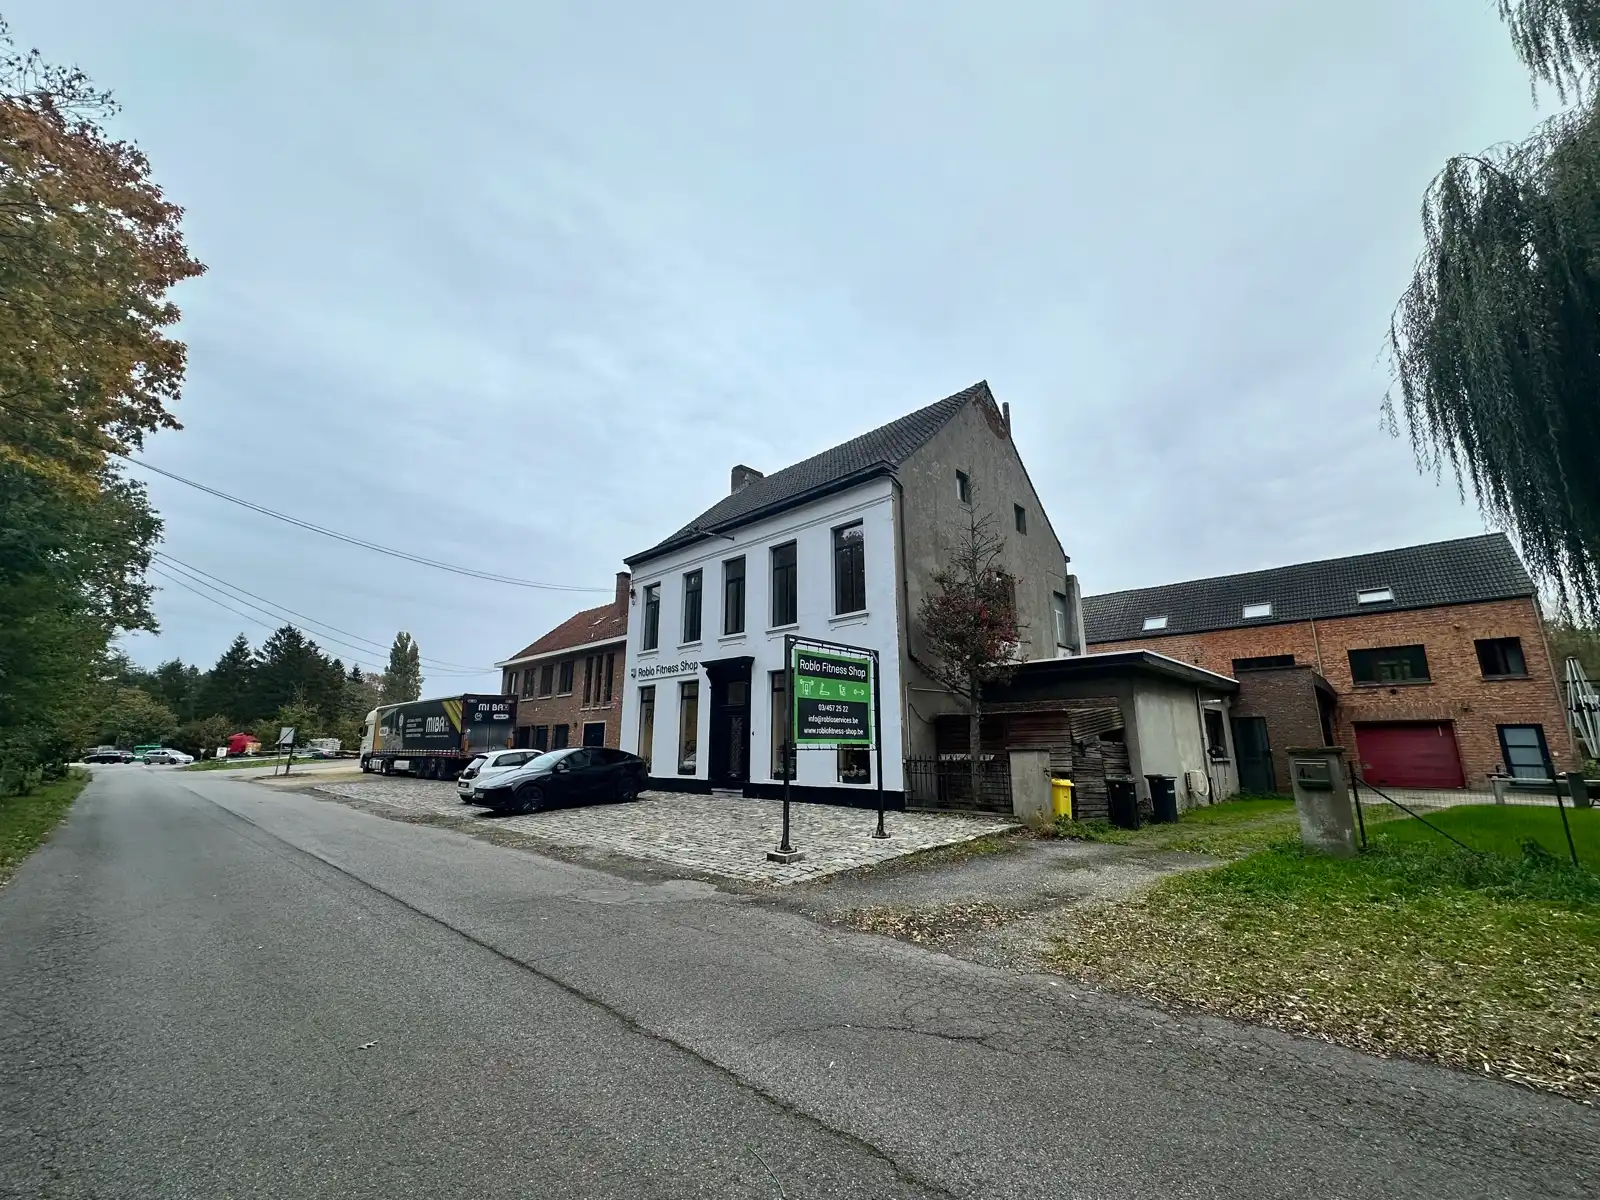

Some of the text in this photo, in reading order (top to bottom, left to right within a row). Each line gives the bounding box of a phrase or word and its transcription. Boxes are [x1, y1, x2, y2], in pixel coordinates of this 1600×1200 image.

[638, 660, 698, 677] Roblo Fitness Shop
[799, 659, 866, 679] Roblo Fitness Shop
[425, 716, 445, 732] MIBA
